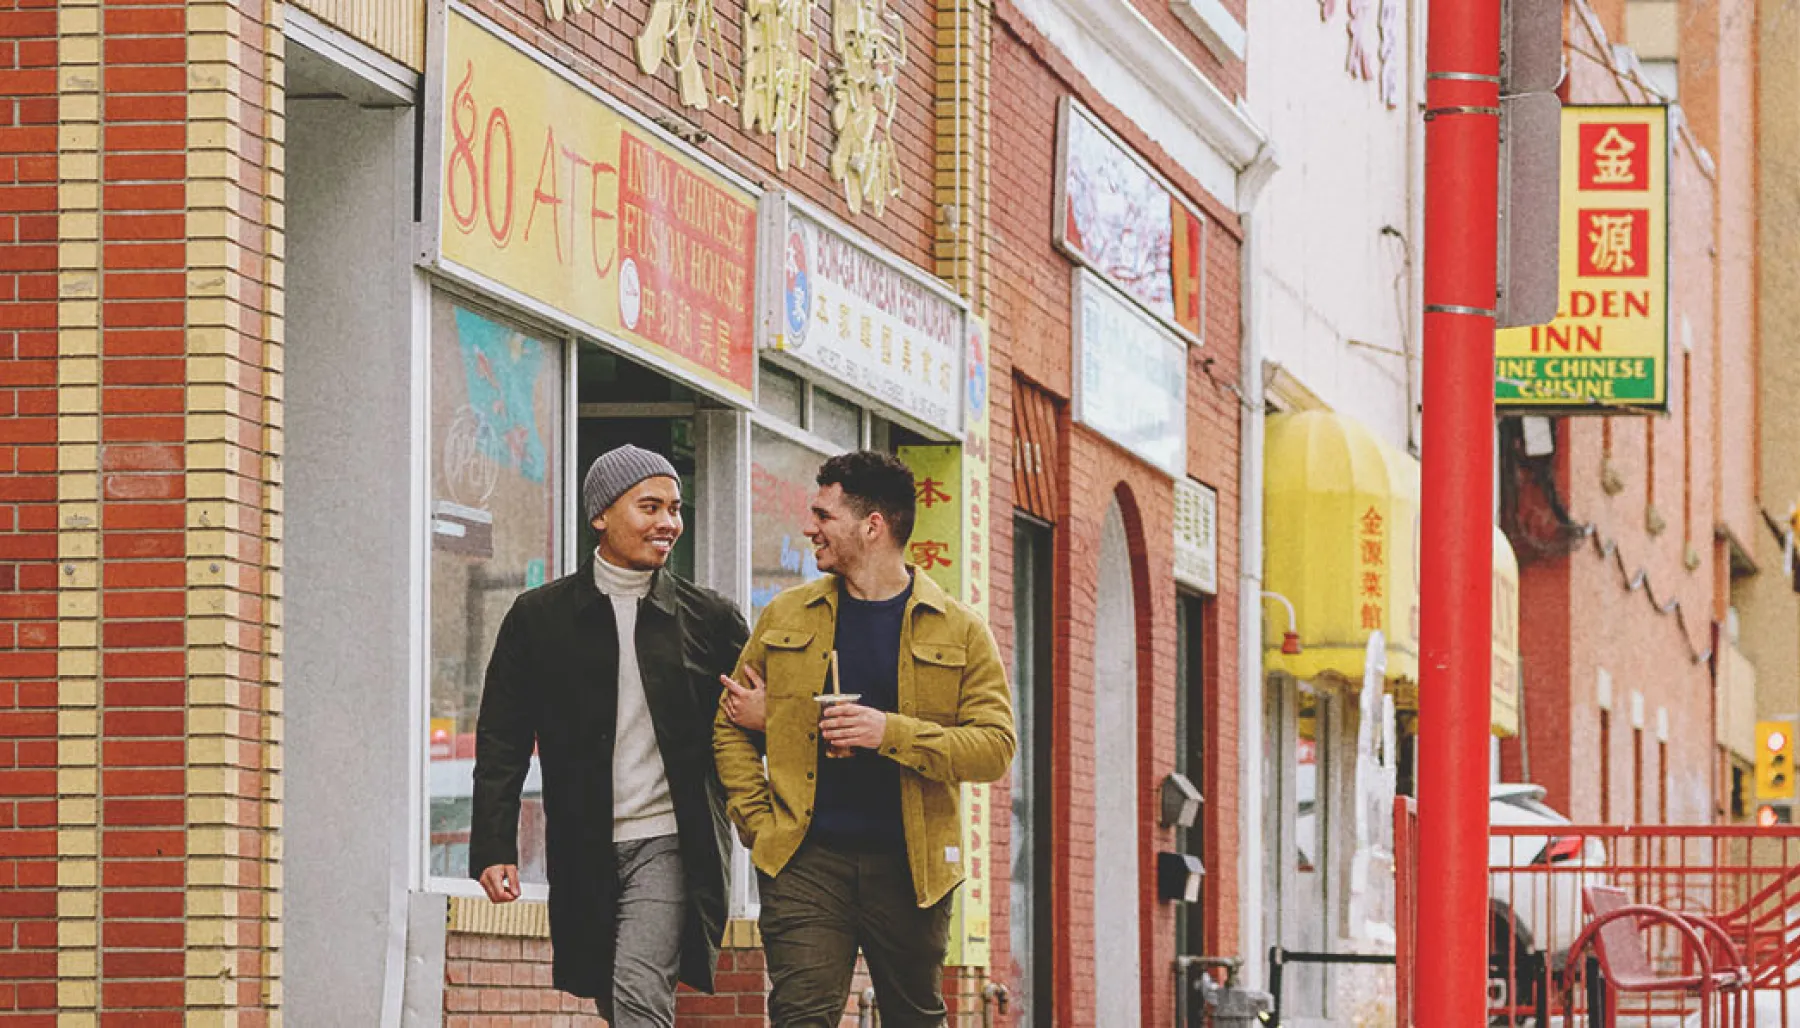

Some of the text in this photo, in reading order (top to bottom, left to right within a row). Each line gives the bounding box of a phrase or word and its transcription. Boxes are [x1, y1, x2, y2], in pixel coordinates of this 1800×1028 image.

[627, 140, 746, 252] INDO CHINESE
[1589, 126, 1636, 273] 金源
[691, 238, 745, 313] HOUSE
[1556, 291, 1650, 318] DEN
[1530, 325, 1603, 353] INN
[1497, 359, 1647, 379] INE CHINESE
[1518, 379, 1615, 398] CUISINE
[910, 476, 952, 570] 本家
